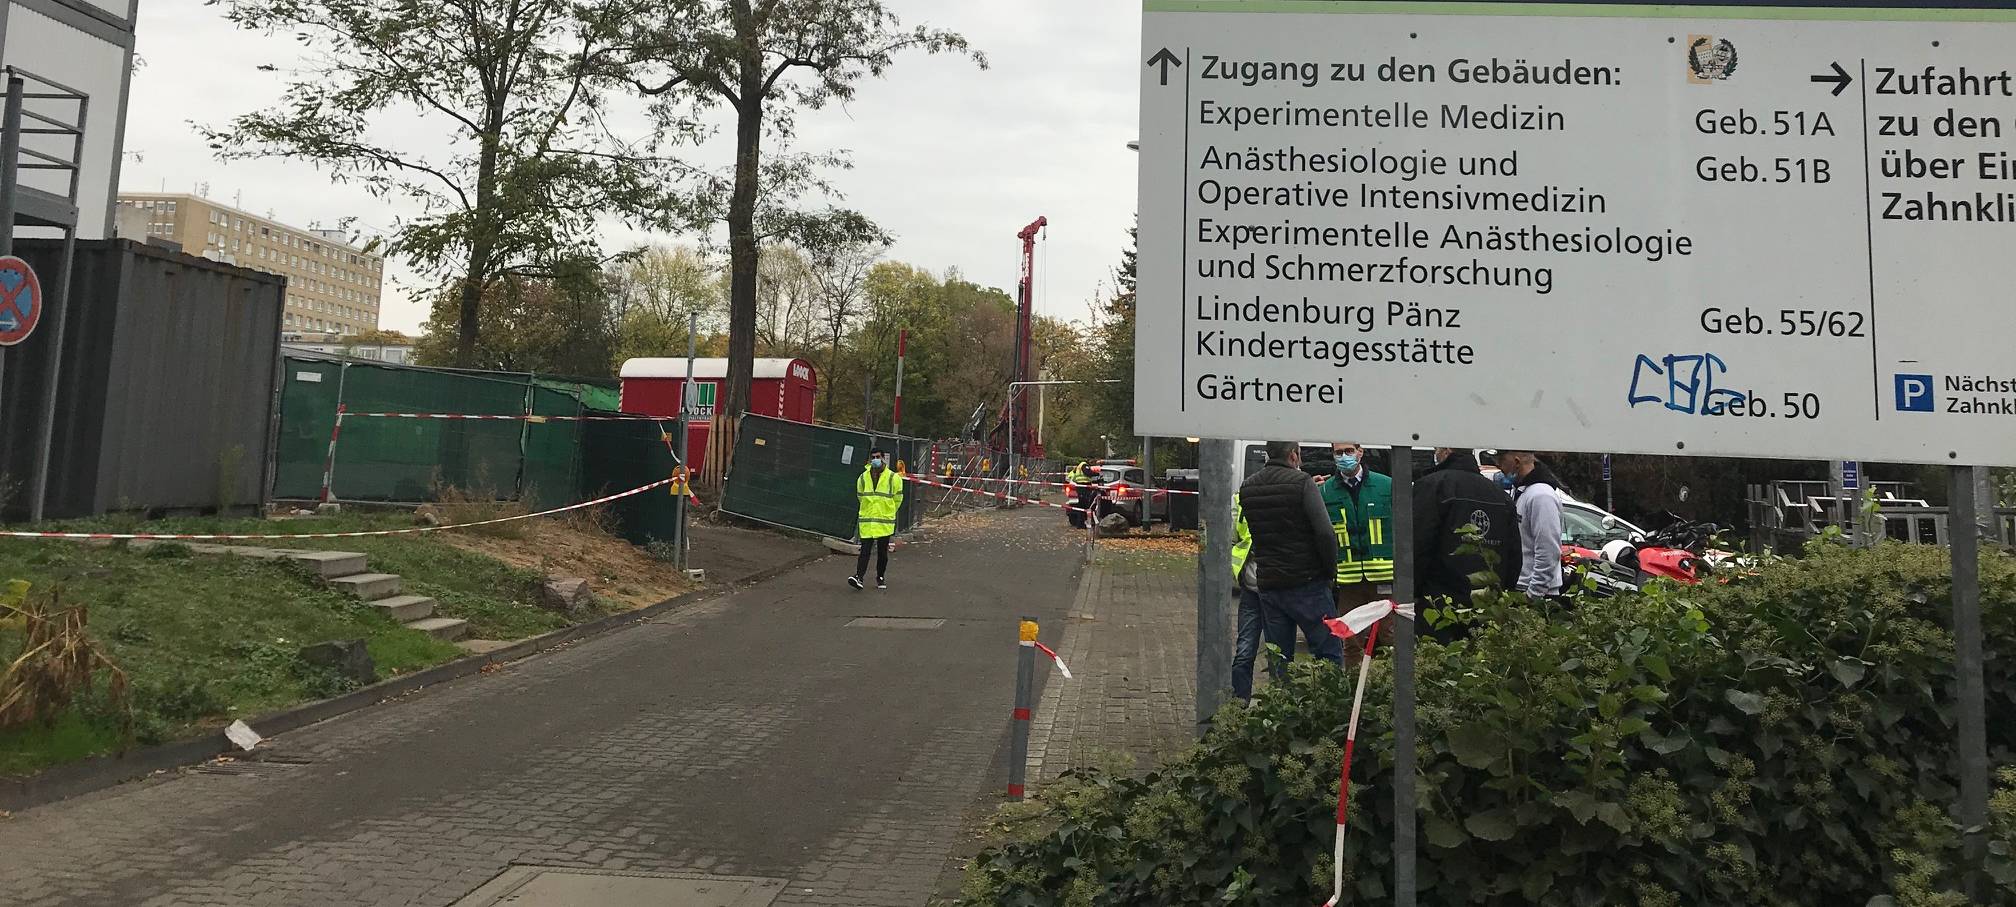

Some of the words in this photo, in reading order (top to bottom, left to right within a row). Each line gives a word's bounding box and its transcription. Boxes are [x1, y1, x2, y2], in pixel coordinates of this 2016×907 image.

[1201, 55, 1319, 88] Zugang
[1330, 63, 1365, 82] zu
[1377, 56, 1436, 83] den
[1447, 57, 1621, 86] Gebäuden:
[1875, 65, 2013, 97] Zufahrt
[1200, 100, 1429, 132] Experimentelle
[1441, 103, 1564, 131] Medizin
[1878, 115, 1919, 137] zu
[1933, 107, 2001, 138] den
[1199, 145, 1447, 182] Anästhesiologie
[1459, 149, 1518, 177] und
[1880, 148, 1966, 179] über
[1978, 151, 2016, 181] Ei
[1198, 179, 1349, 212] Operative
[1361, 183, 1606, 214] Intensivmedizin
[1198, 217, 1429, 251] Experimentelle
[1439, 224, 1693, 262] Anästhesiologie
[1198, 252, 1255, 280] und
[1265, 253, 1553, 295] Schmerzforschung
[1197, 294, 1374, 335] Lindenburg
[1387, 300, 1461, 328] Pänz
[1197, 330, 1474, 368] Kindertagesstätte
[1196, 373, 1343, 404] Gärtnerei
[1903, 379, 1926, 408] P
[1783, 392, 1820, 420] 50
